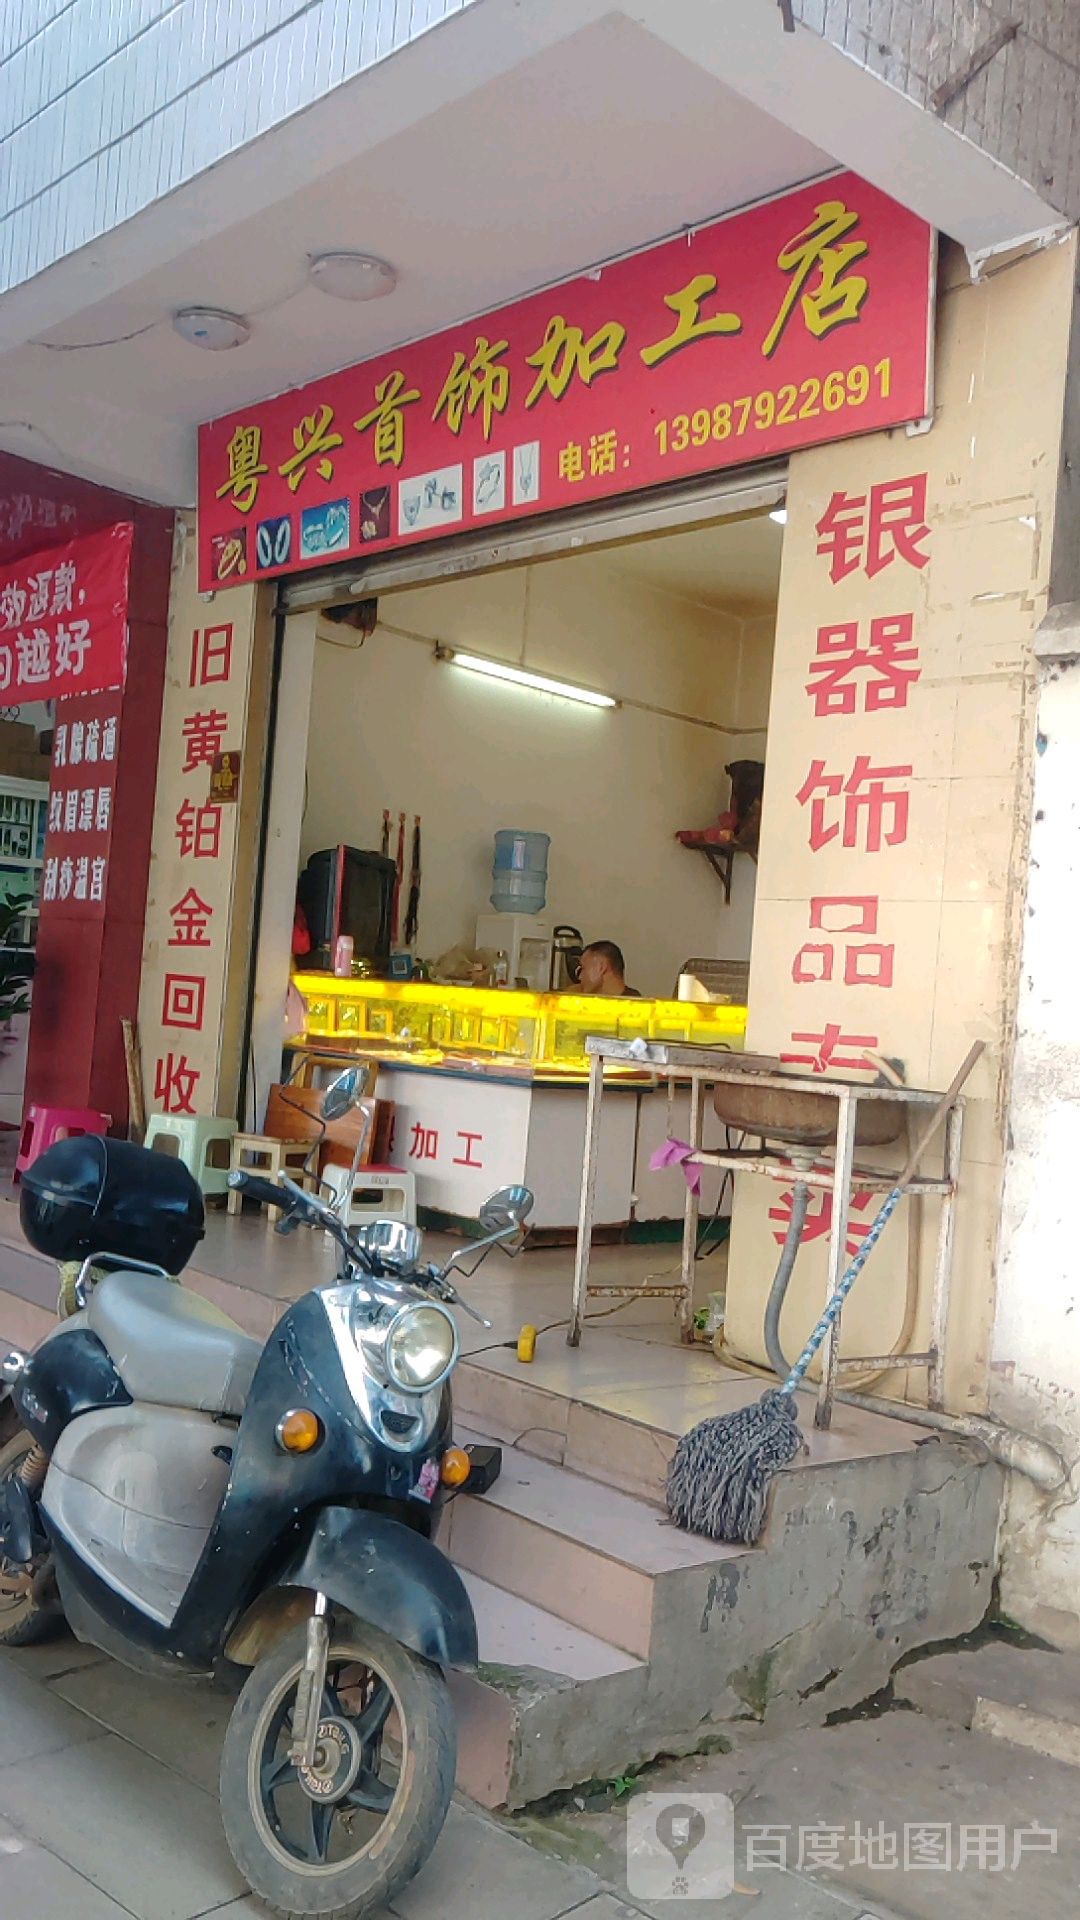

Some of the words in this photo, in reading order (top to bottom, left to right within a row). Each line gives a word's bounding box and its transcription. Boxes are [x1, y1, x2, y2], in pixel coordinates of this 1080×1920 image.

[216, 201, 870, 514] 粤兴首饰加工店
[653, 355, 893, 457] 13987922691
[153, 621, 234, 1115] 旧黄铂金回收
[389, 1115, 482, 1168] 加工
